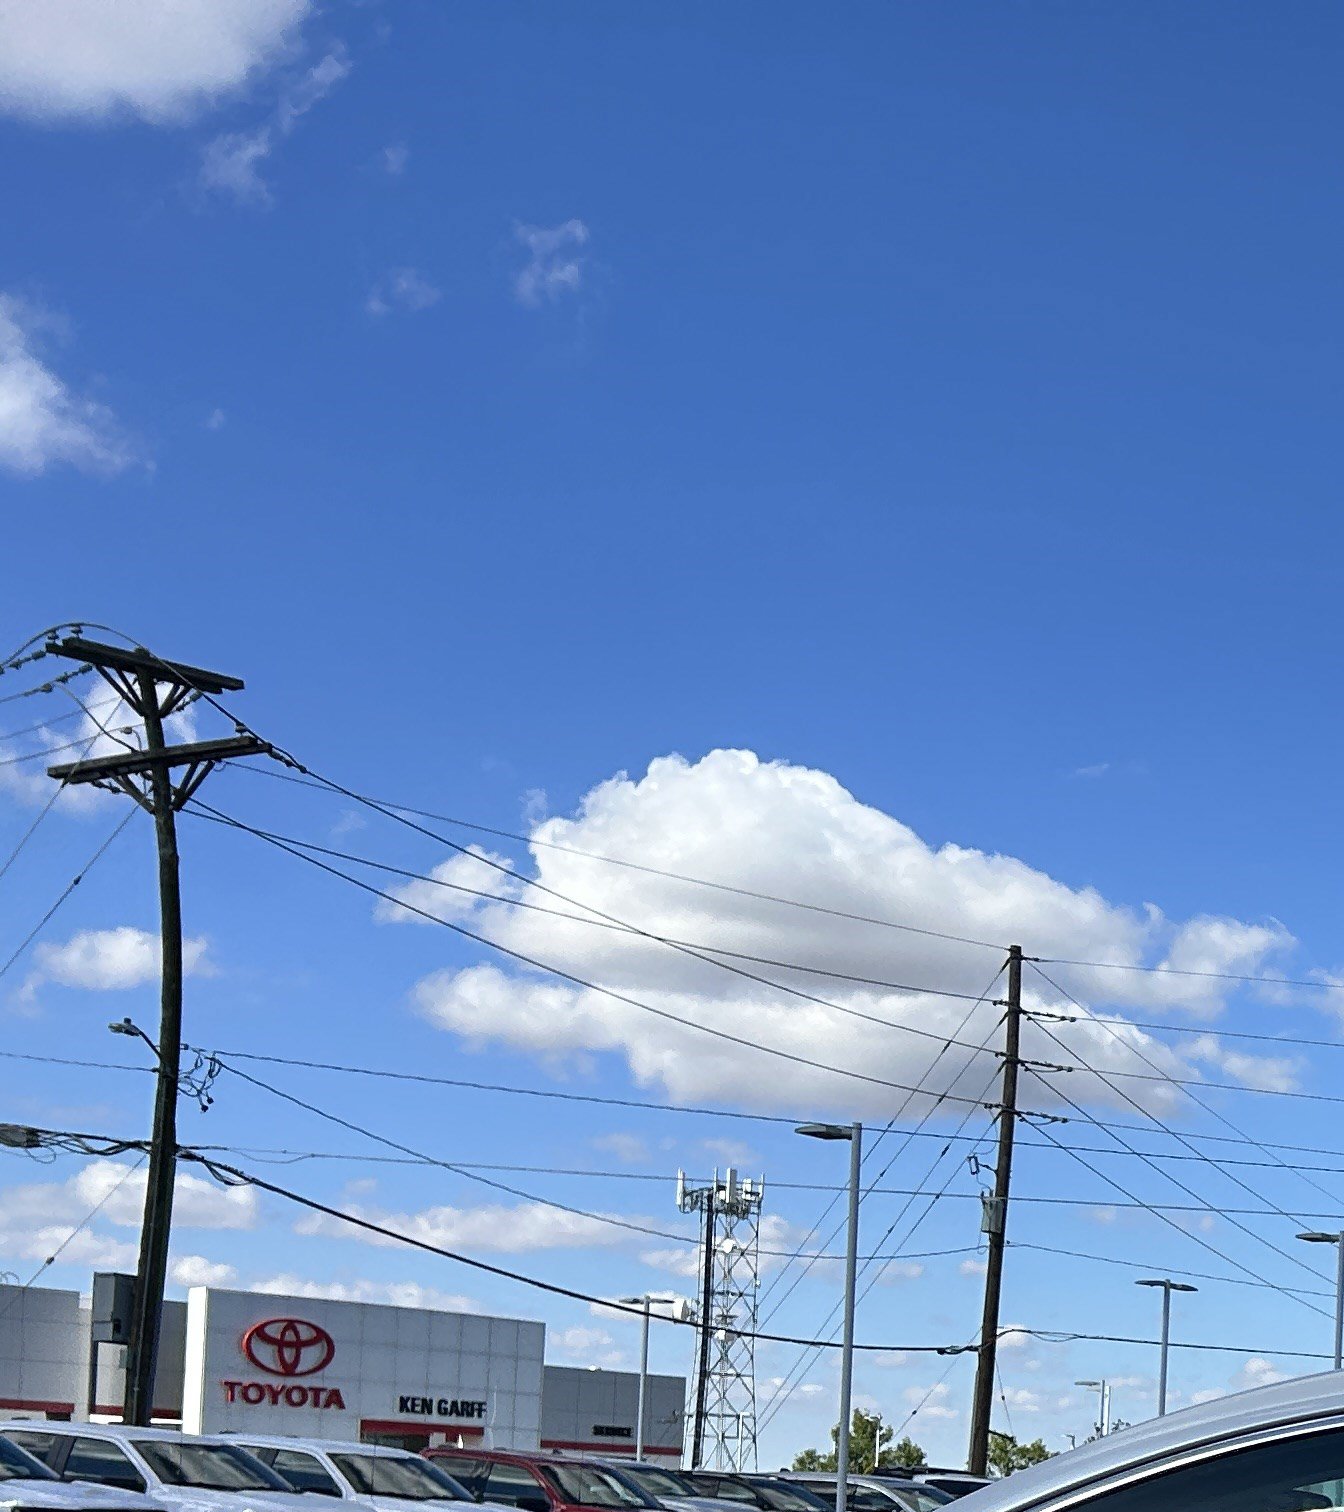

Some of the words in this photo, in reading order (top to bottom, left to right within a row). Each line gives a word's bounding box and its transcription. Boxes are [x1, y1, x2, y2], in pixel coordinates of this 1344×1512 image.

[222, 1381, 346, 1409] TOYOTA
[399, 1396, 433, 1415] KEN
[437, 1399, 487, 1418] GARFF
